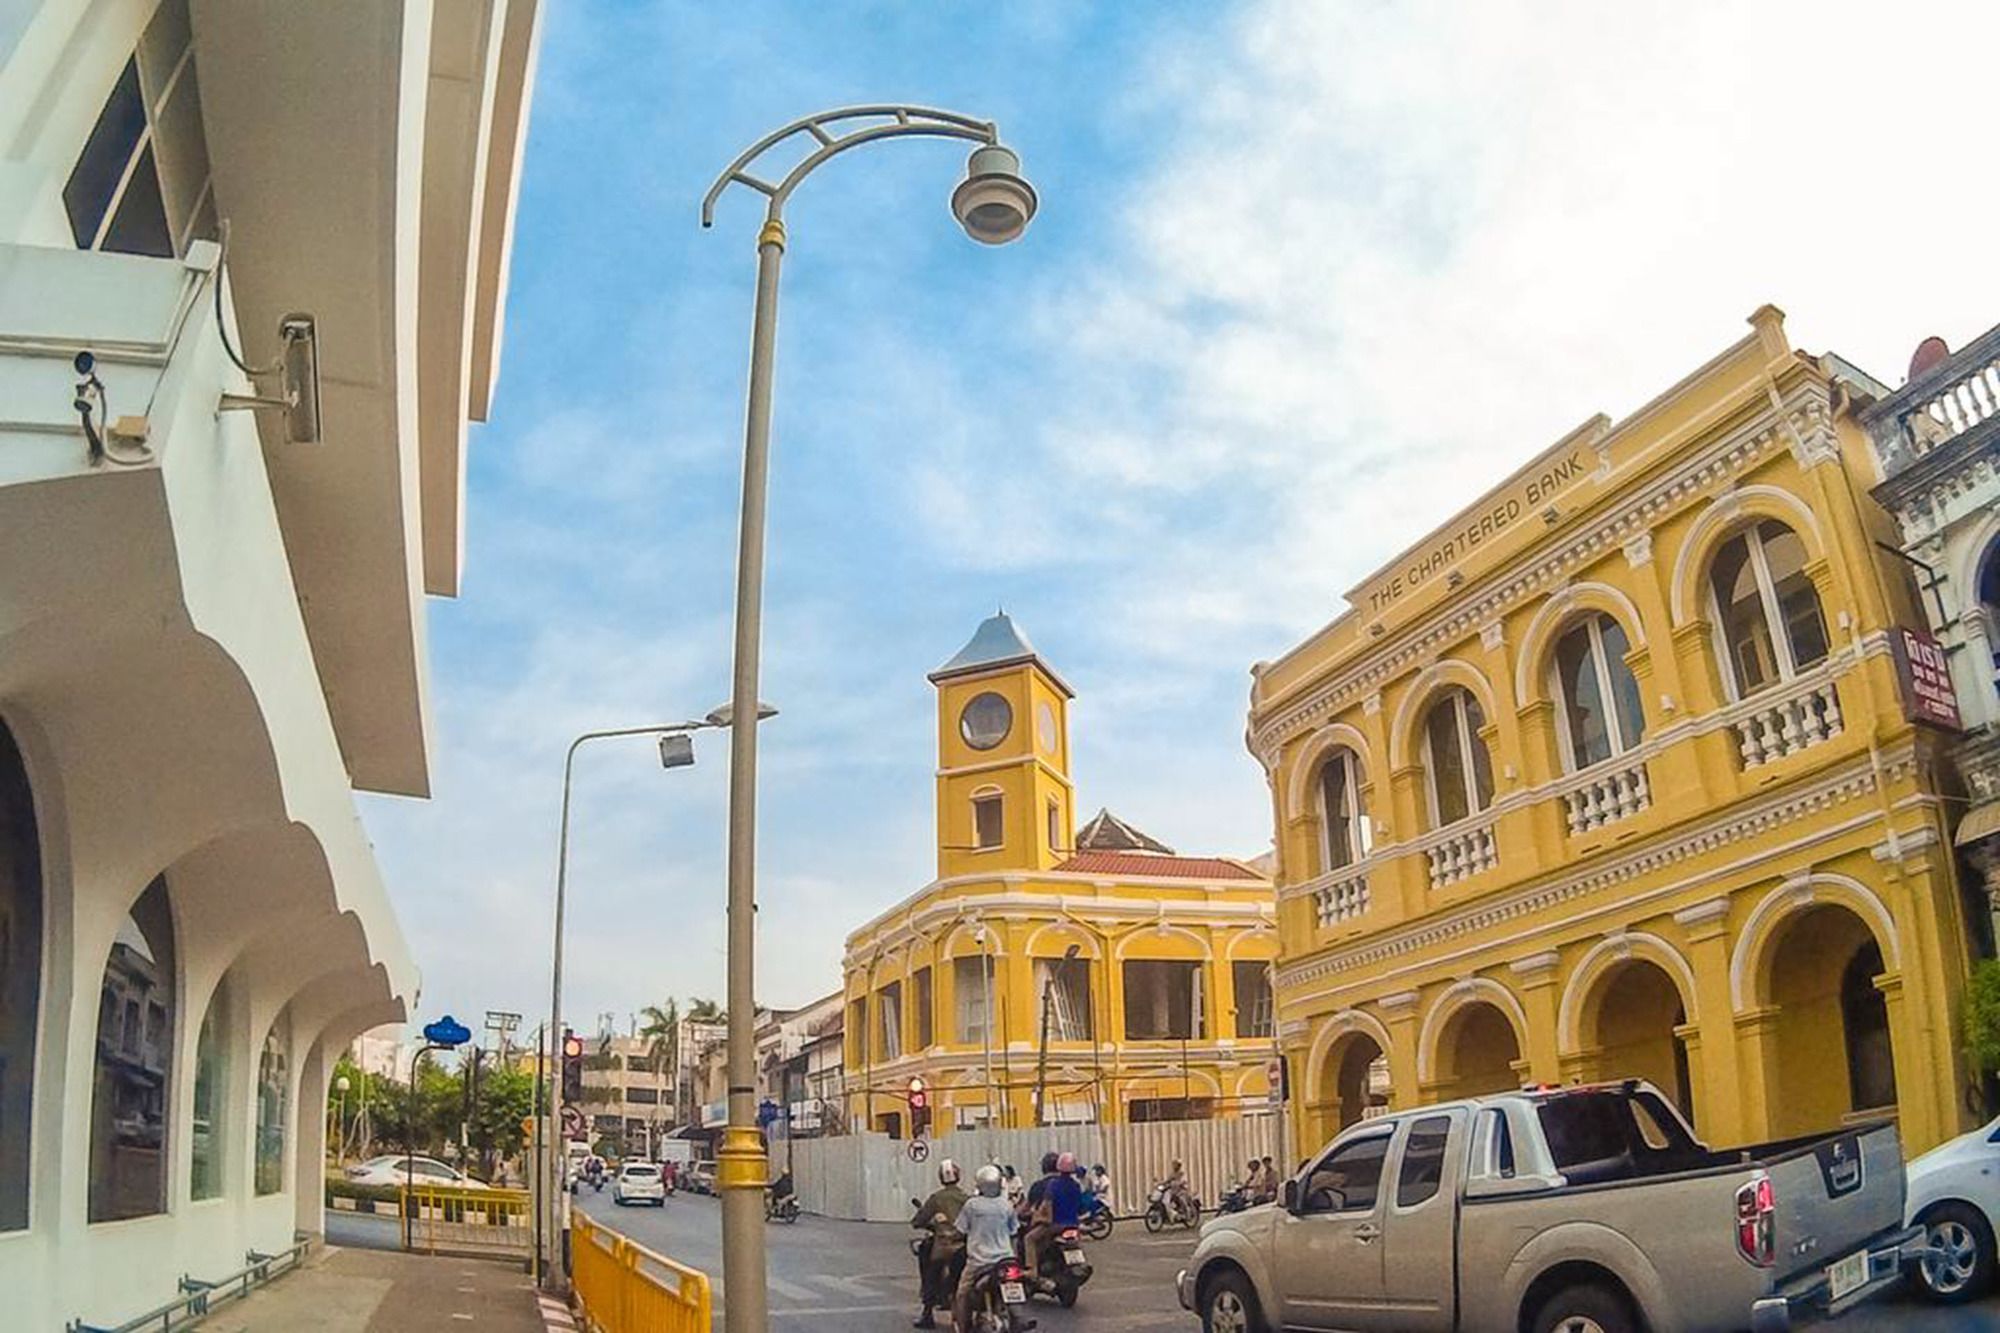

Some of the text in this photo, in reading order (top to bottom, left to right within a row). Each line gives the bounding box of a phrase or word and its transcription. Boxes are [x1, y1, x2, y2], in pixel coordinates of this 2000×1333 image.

[1369, 451, 1583, 611] THE CHARTERED BANK
